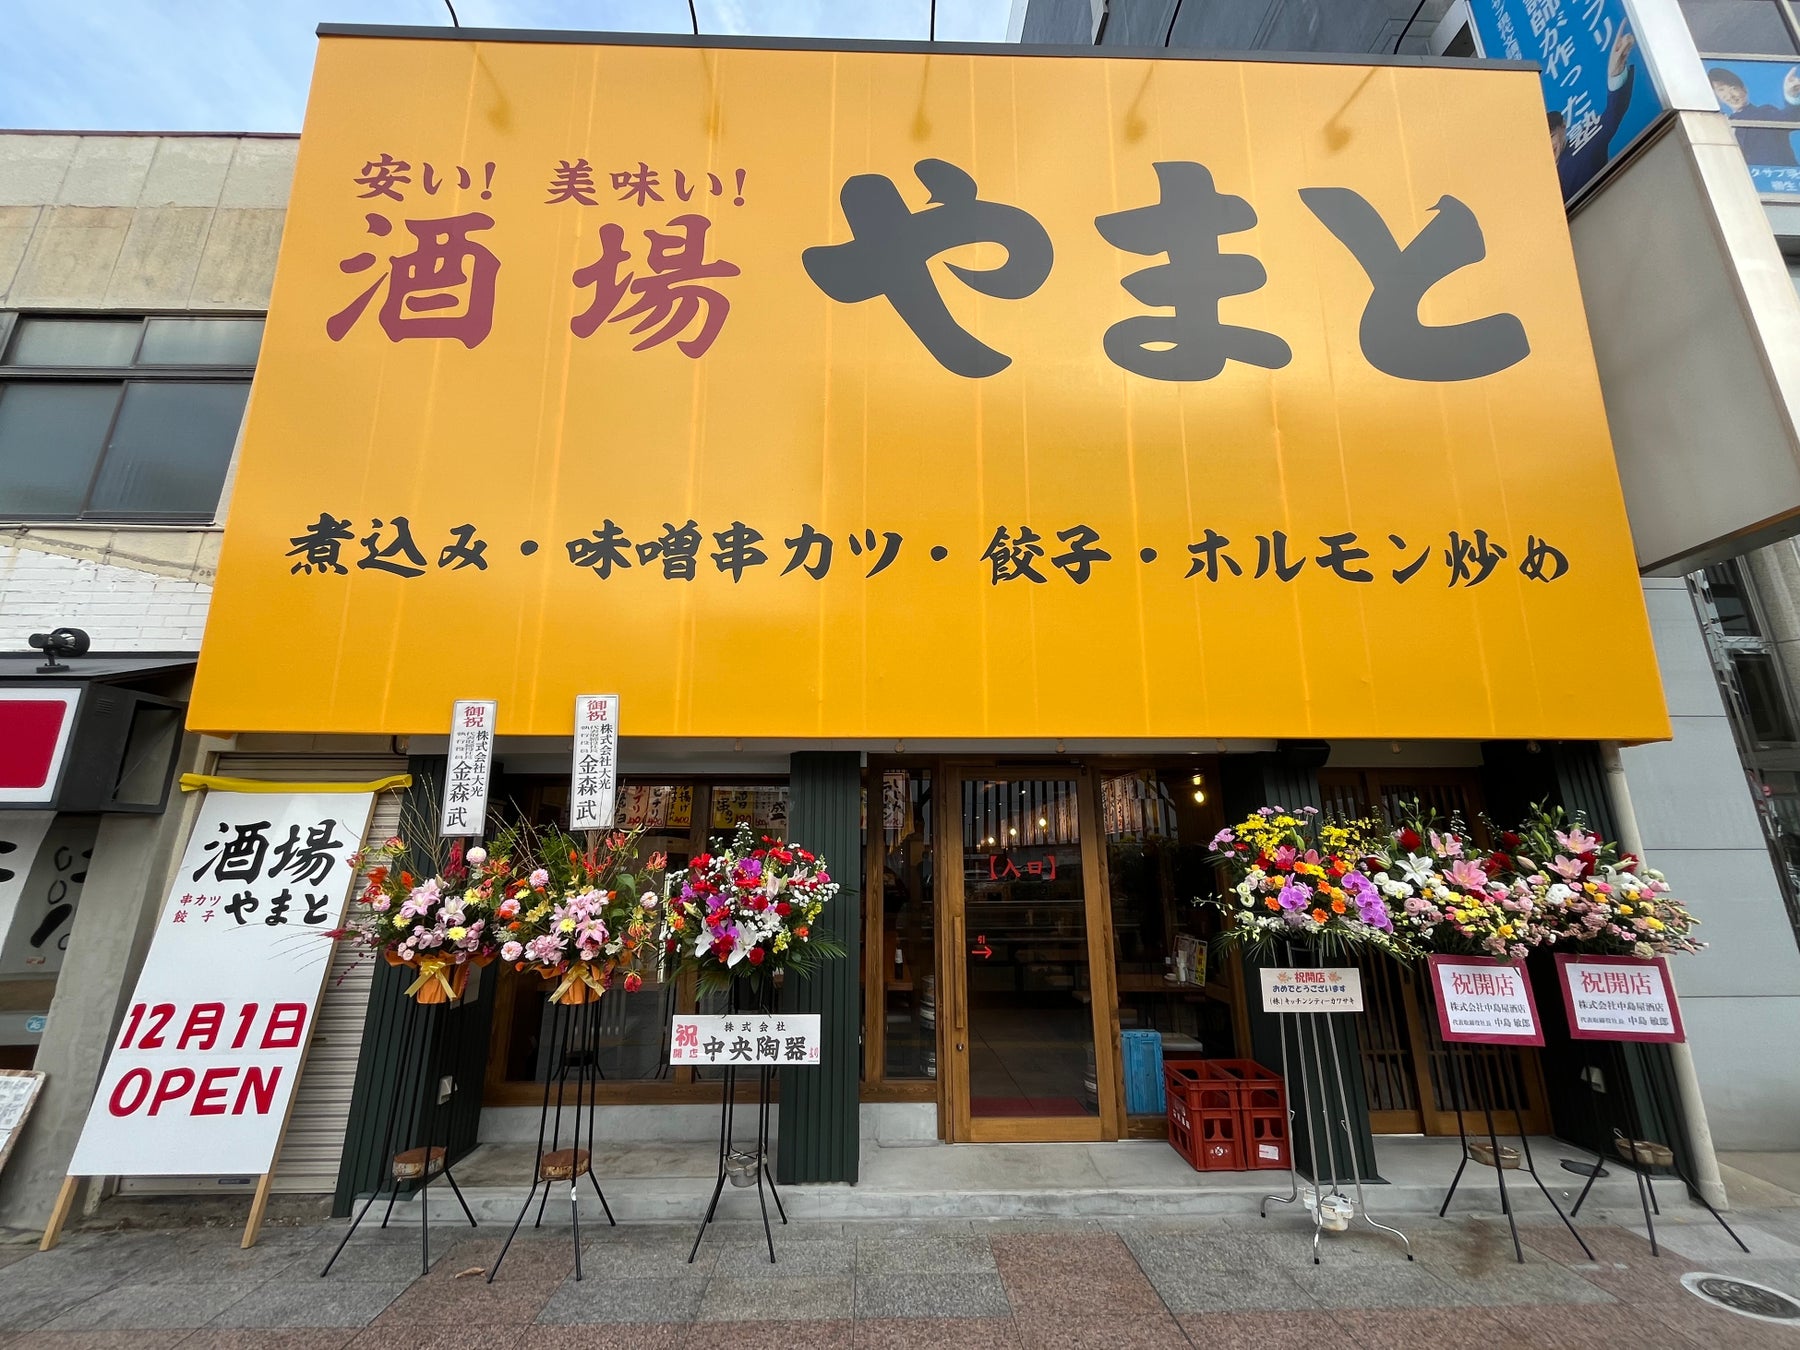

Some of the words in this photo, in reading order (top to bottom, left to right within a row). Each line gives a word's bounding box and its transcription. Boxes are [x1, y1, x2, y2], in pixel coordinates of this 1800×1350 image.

[353, 153, 496, 202] 安い！
[543, 158, 747, 207] 美味い！
[326, 211, 741, 359] 酒場
[802, 160, 1531, 383] やまと
[463, 705, 486, 728] 御祝
[586, 699, 608, 722] 御祝
[471, 729, 490, 798] 株式会社大光
[598, 723, 614, 790] 株式会社大光
[449, 760, 473, 803] 金森
[577, 754, 599, 796] 金森
[446, 806, 468, 828] 武
[576, 799, 597, 821] 武
[192, 817, 345, 886] 酒場
[179, 892, 222, 907] 串カツ
[223, 888, 330, 926] やまと
[172, 908, 216, 924] 餃子
[1272, 985, 1346, 993] おめでとうございます
[1294, 971, 1326, 984] 祝開店
[1451, 972, 1516, 998] 祝開店
[1580, 970, 1653, 996] 祝開店
[119, 1002, 308, 1051] 12月1日
[674, 1024, 699, 1047] 祝
[724, 1021, 787, 1033] 株式会社
[702, 1035, 808, 1062] 中央陶器
[108, 1066, 283, 1118] OPEN
